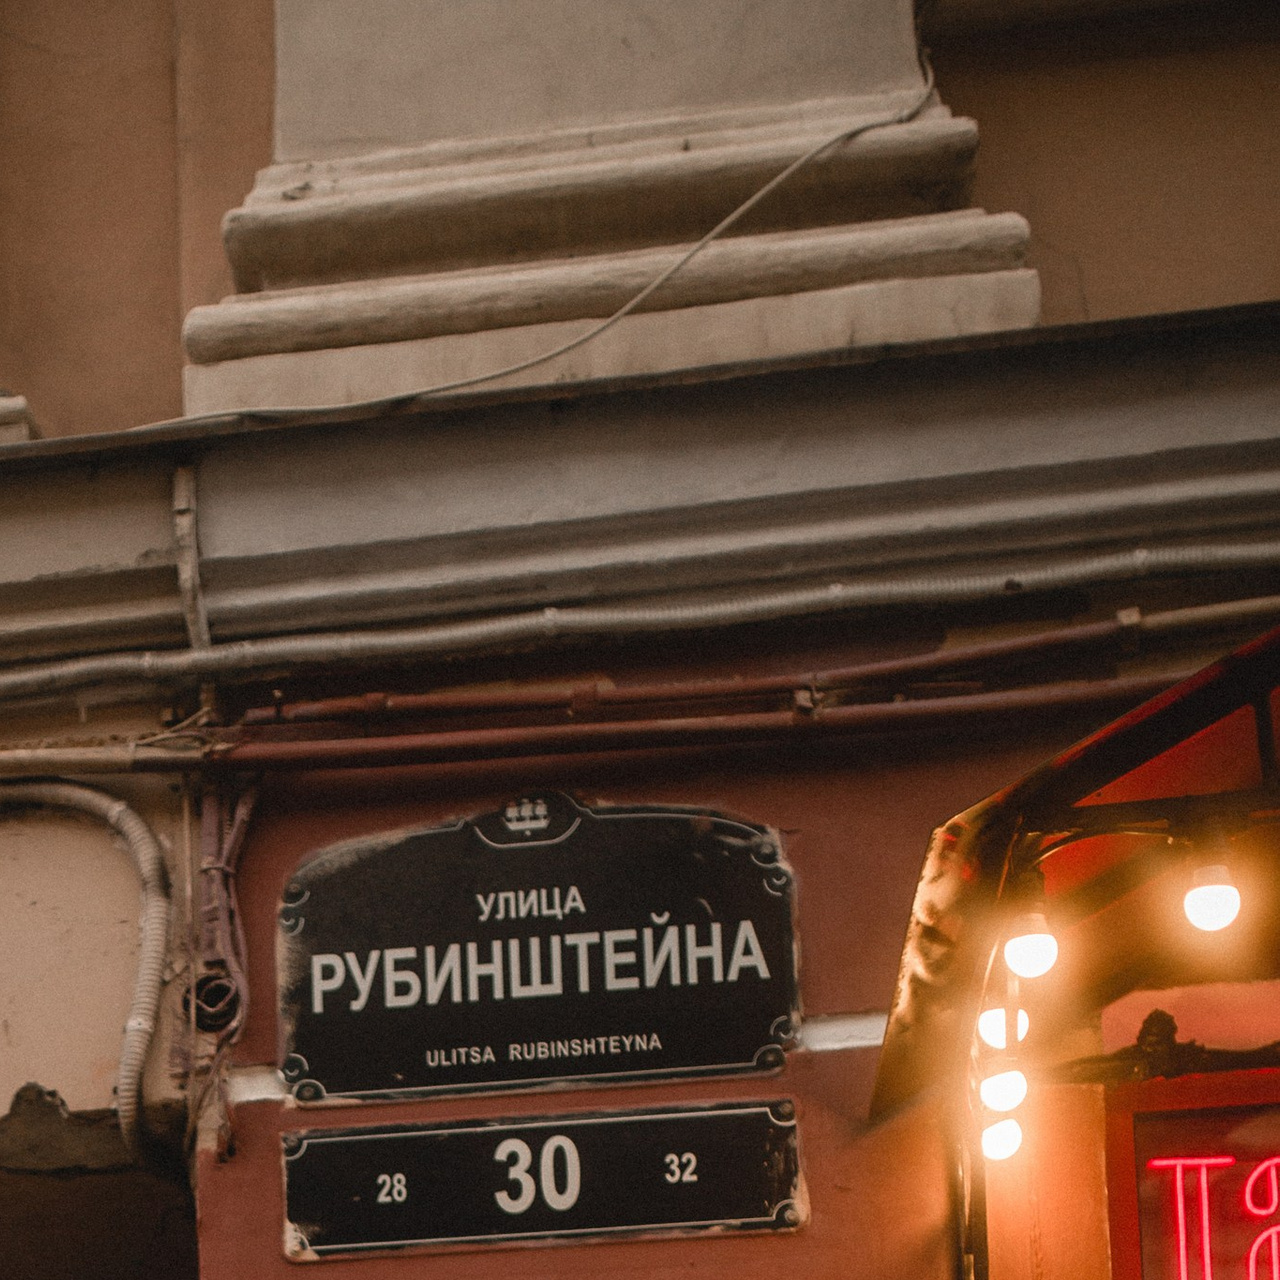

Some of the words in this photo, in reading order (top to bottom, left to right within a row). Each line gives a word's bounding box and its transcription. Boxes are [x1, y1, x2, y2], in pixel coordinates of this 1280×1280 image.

[476, 885, 586, 922] УЛИЦА
[310, 911, 771, 1014] РУБИНШТЕЙНА
[426, 1045, 496, 1067] ULITSA
[508, 1032, 663, 1061] RUBINSHTEYNA
[377, 1172, 408, 1204] 28
[493, 1134, 581, 1214] 30
[664, 1152, 699, 1184] 32
